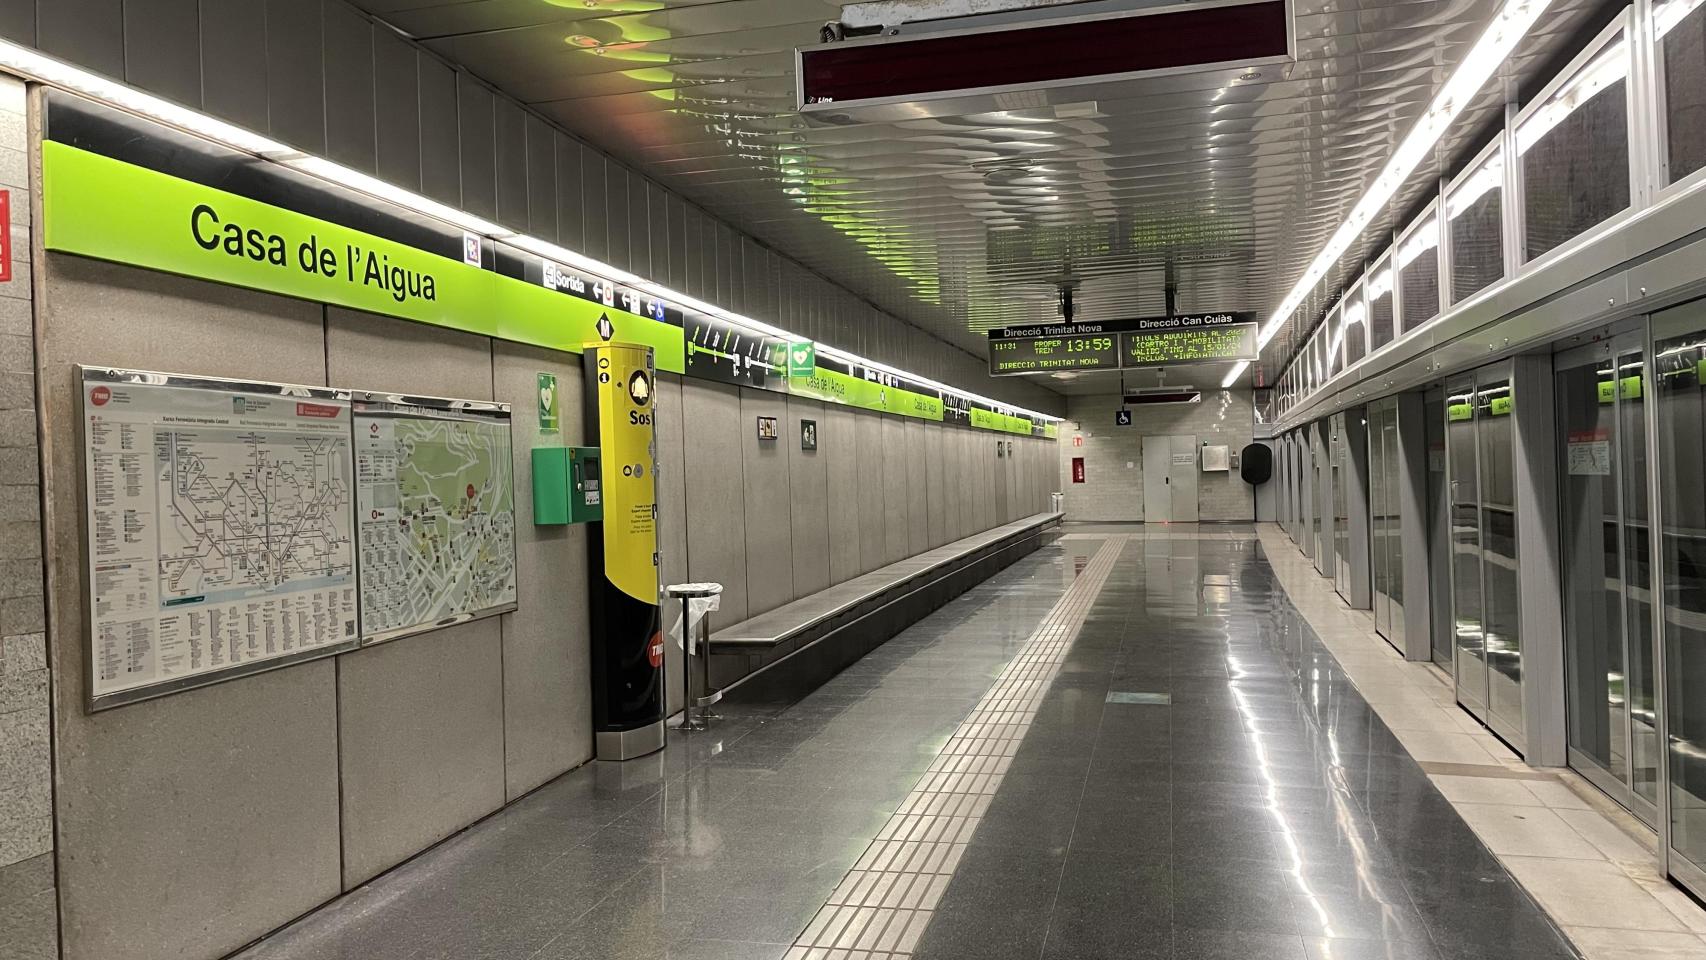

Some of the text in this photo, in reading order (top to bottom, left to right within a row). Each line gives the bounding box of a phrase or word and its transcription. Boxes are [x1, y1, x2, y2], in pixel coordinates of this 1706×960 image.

[818, 96, 833, 104] Line
[191, 204, 436, 302] Casa de l'Aigua
[556, 271, 585, 294] Sortida
[1140, 315, 1233, 328] Direcció Can Cuiàs
[1004, 324, 1102, 337] Direcció Trinitat Nova
[995, 342, 1016, 350] 11:31
[1034, 340, 1061, 348] PROPER
[1067, 338, 1112, 352] 13:59
[1040, 359, 1075, 367] TRINITAT
[1080, 358, 1099, 366] NOVA
[806, 374, 819, 387] Casa
[820, 376, 828, 390] de
[630, 410, 651, 425] Sos
